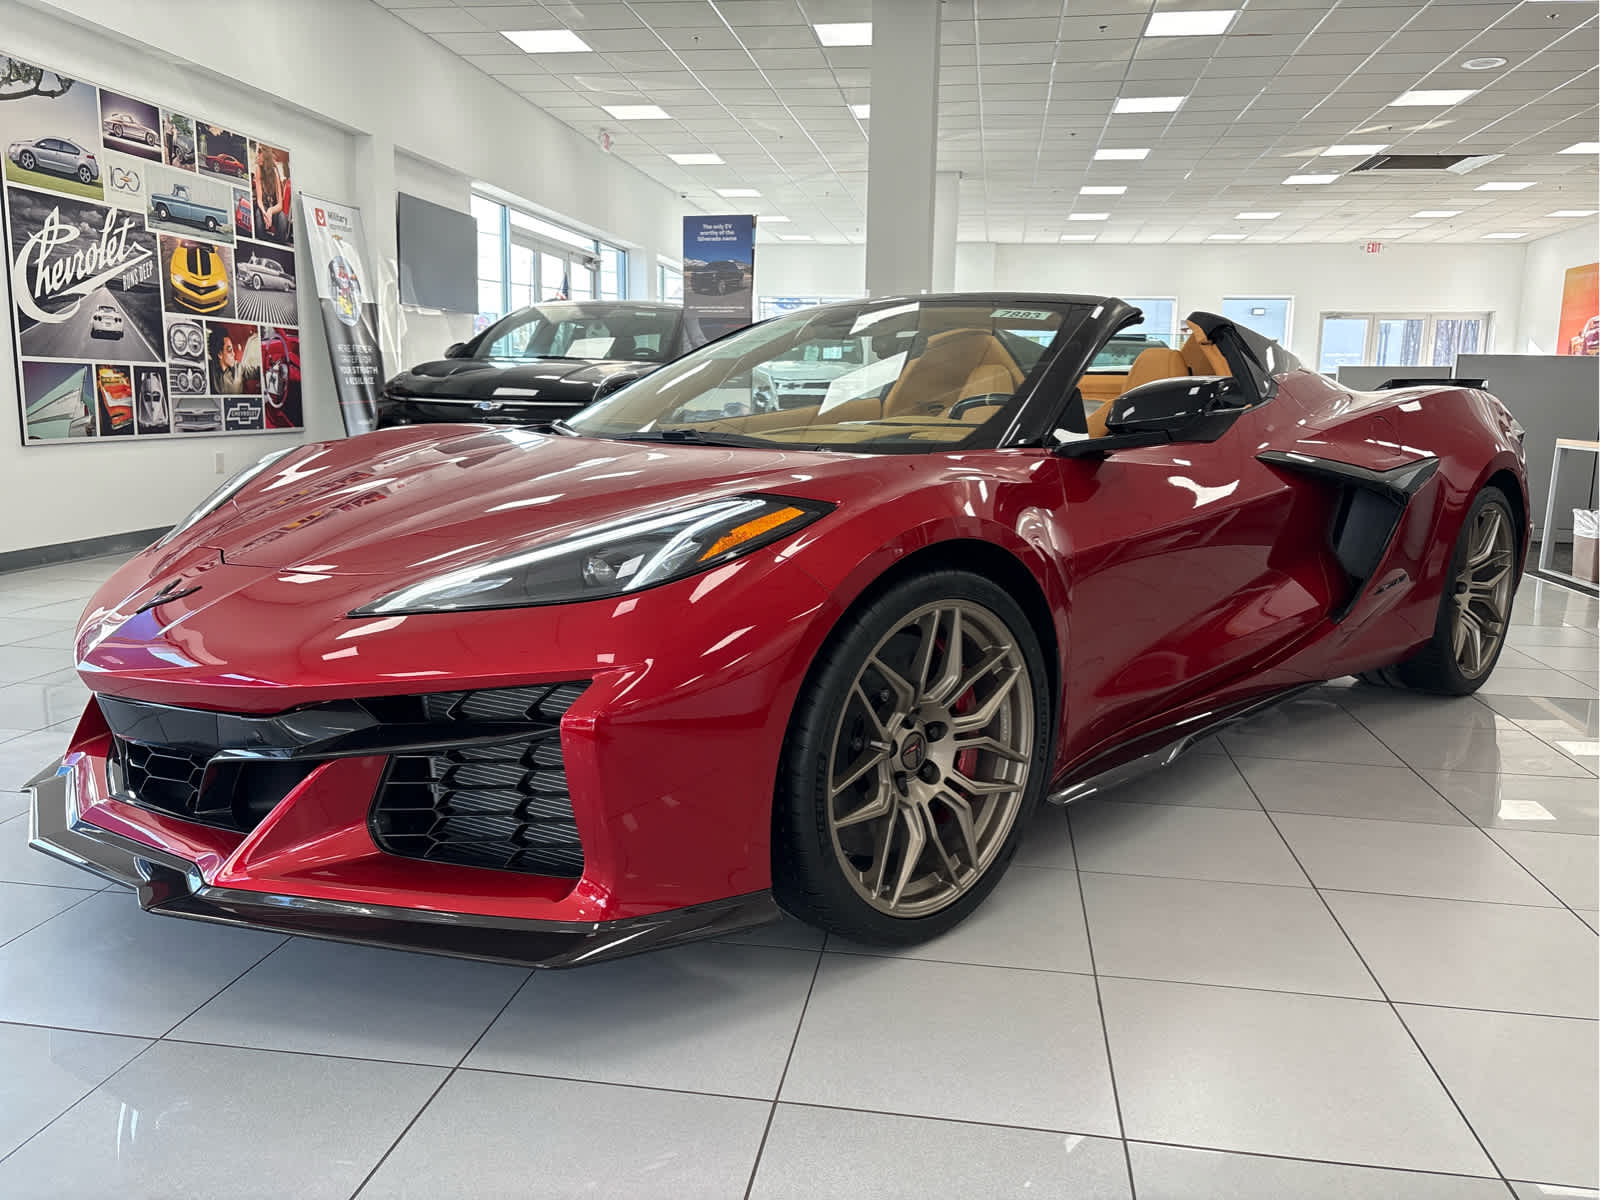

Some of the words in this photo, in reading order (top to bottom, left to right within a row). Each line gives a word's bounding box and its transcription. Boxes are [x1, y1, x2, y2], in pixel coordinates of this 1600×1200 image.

[327, 211, 348, 226] Military
[1367, 242, 1382, 254] EXIT
[14, 205, 136, 323] Chevrolet
[122, 267, 138, 291] RUNS
[138, 259, 153, 282] DEEP
